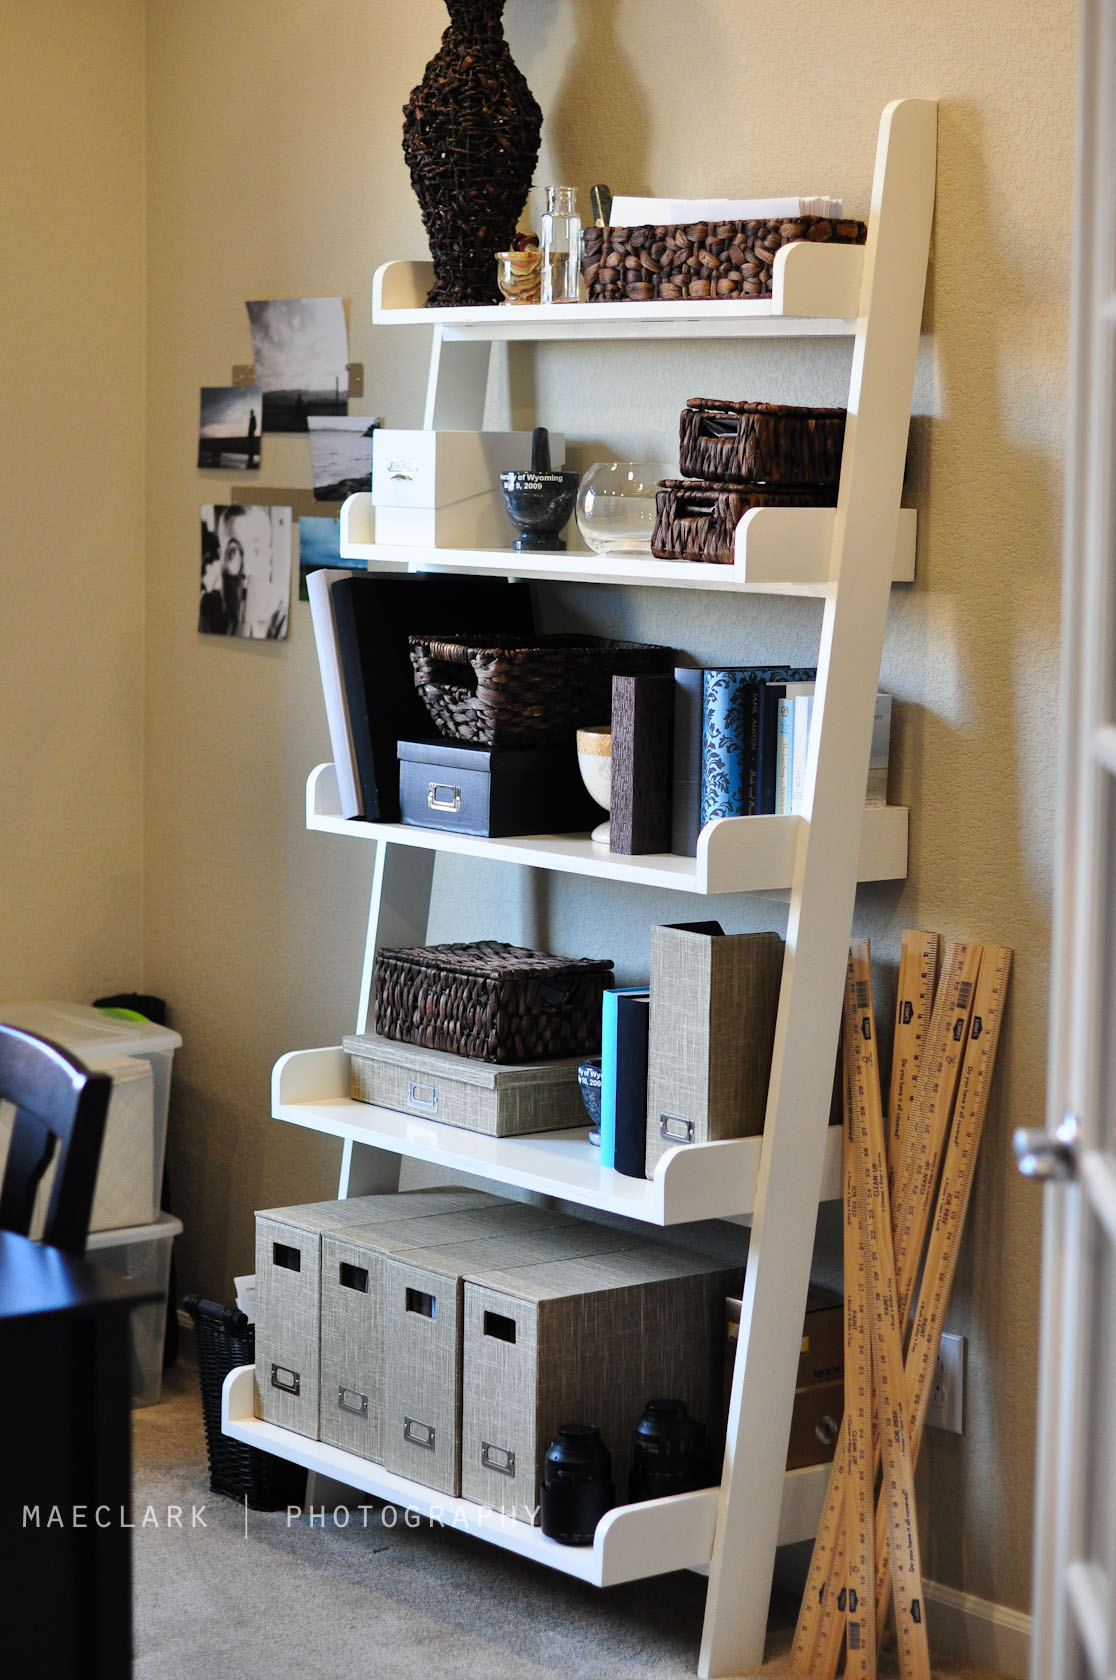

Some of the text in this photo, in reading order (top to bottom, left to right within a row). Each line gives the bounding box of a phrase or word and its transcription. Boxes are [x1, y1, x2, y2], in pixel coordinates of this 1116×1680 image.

[526, 474, 564, 482] Wyoming
[524, 482, 542, 490] 2009
[966, 1066, 974, 1076] Do
[872, 1162, 878, 1172] UP
[920, 1161, 930, 1195] CLEAN UP
[920, 1317, 928, 1338] PAINT
